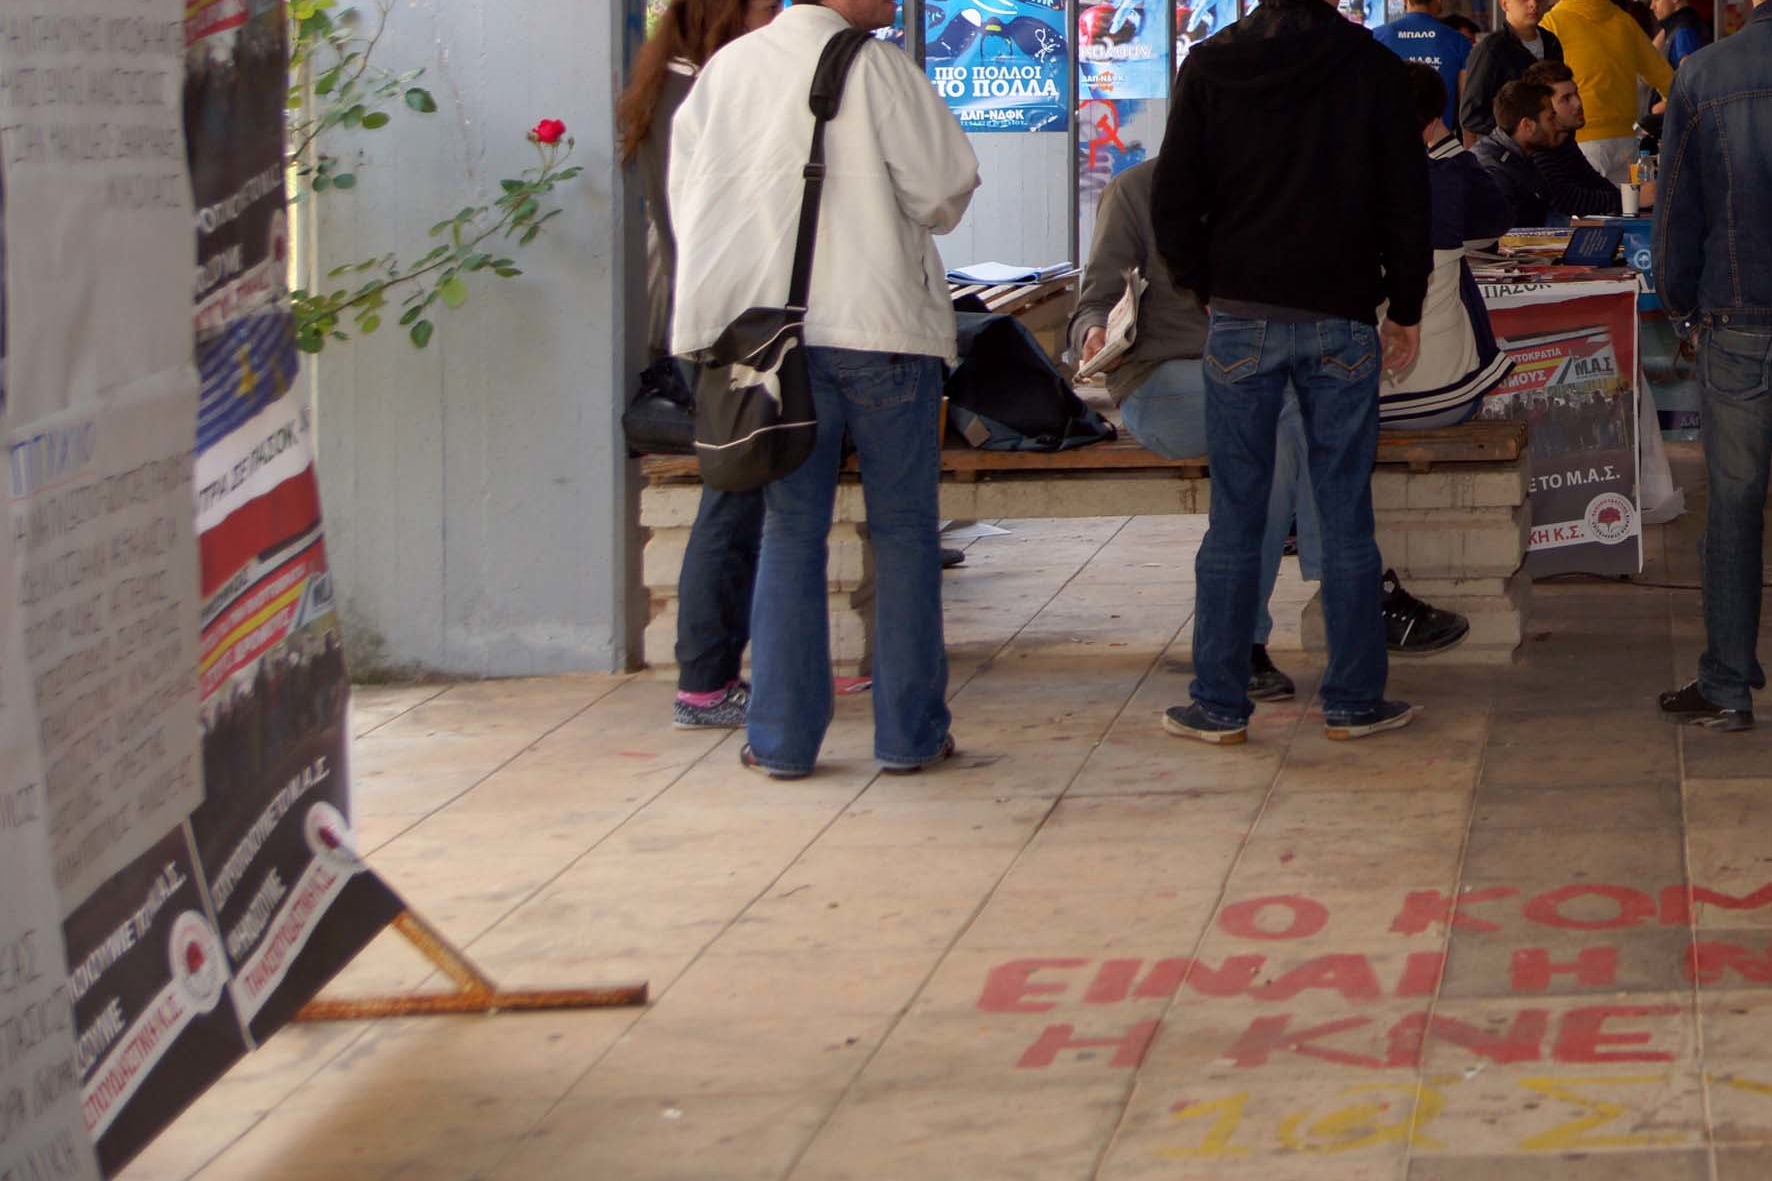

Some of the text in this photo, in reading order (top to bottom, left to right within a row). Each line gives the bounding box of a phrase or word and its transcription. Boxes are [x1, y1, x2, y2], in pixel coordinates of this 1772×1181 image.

[935, 66, 1041, 80] ΠΙΟ ΠΟΛΛΟΙ
[972, 79, 1058, 97] ΠΟΛΛΑ
[960, 109, 1025, 120] ΔΑΠ-ΝΔΦΚ
[1539, 475, 1562, 492] ΤΟ
[1566, 465, 1621, 487] Μ.Α.Σ.
[1554, 525, 1585, 542] Κ.Σ.
[1218, 894, 1329, 940] Ο
[974, 950, 1450, 1013] ΕΙΝΑΙ
[1510, 946, 1621, 991] Η
[1016, 1020, 1160, 1068] Η
[1231, 1004, 1692, 1068] ΚΝΕ
